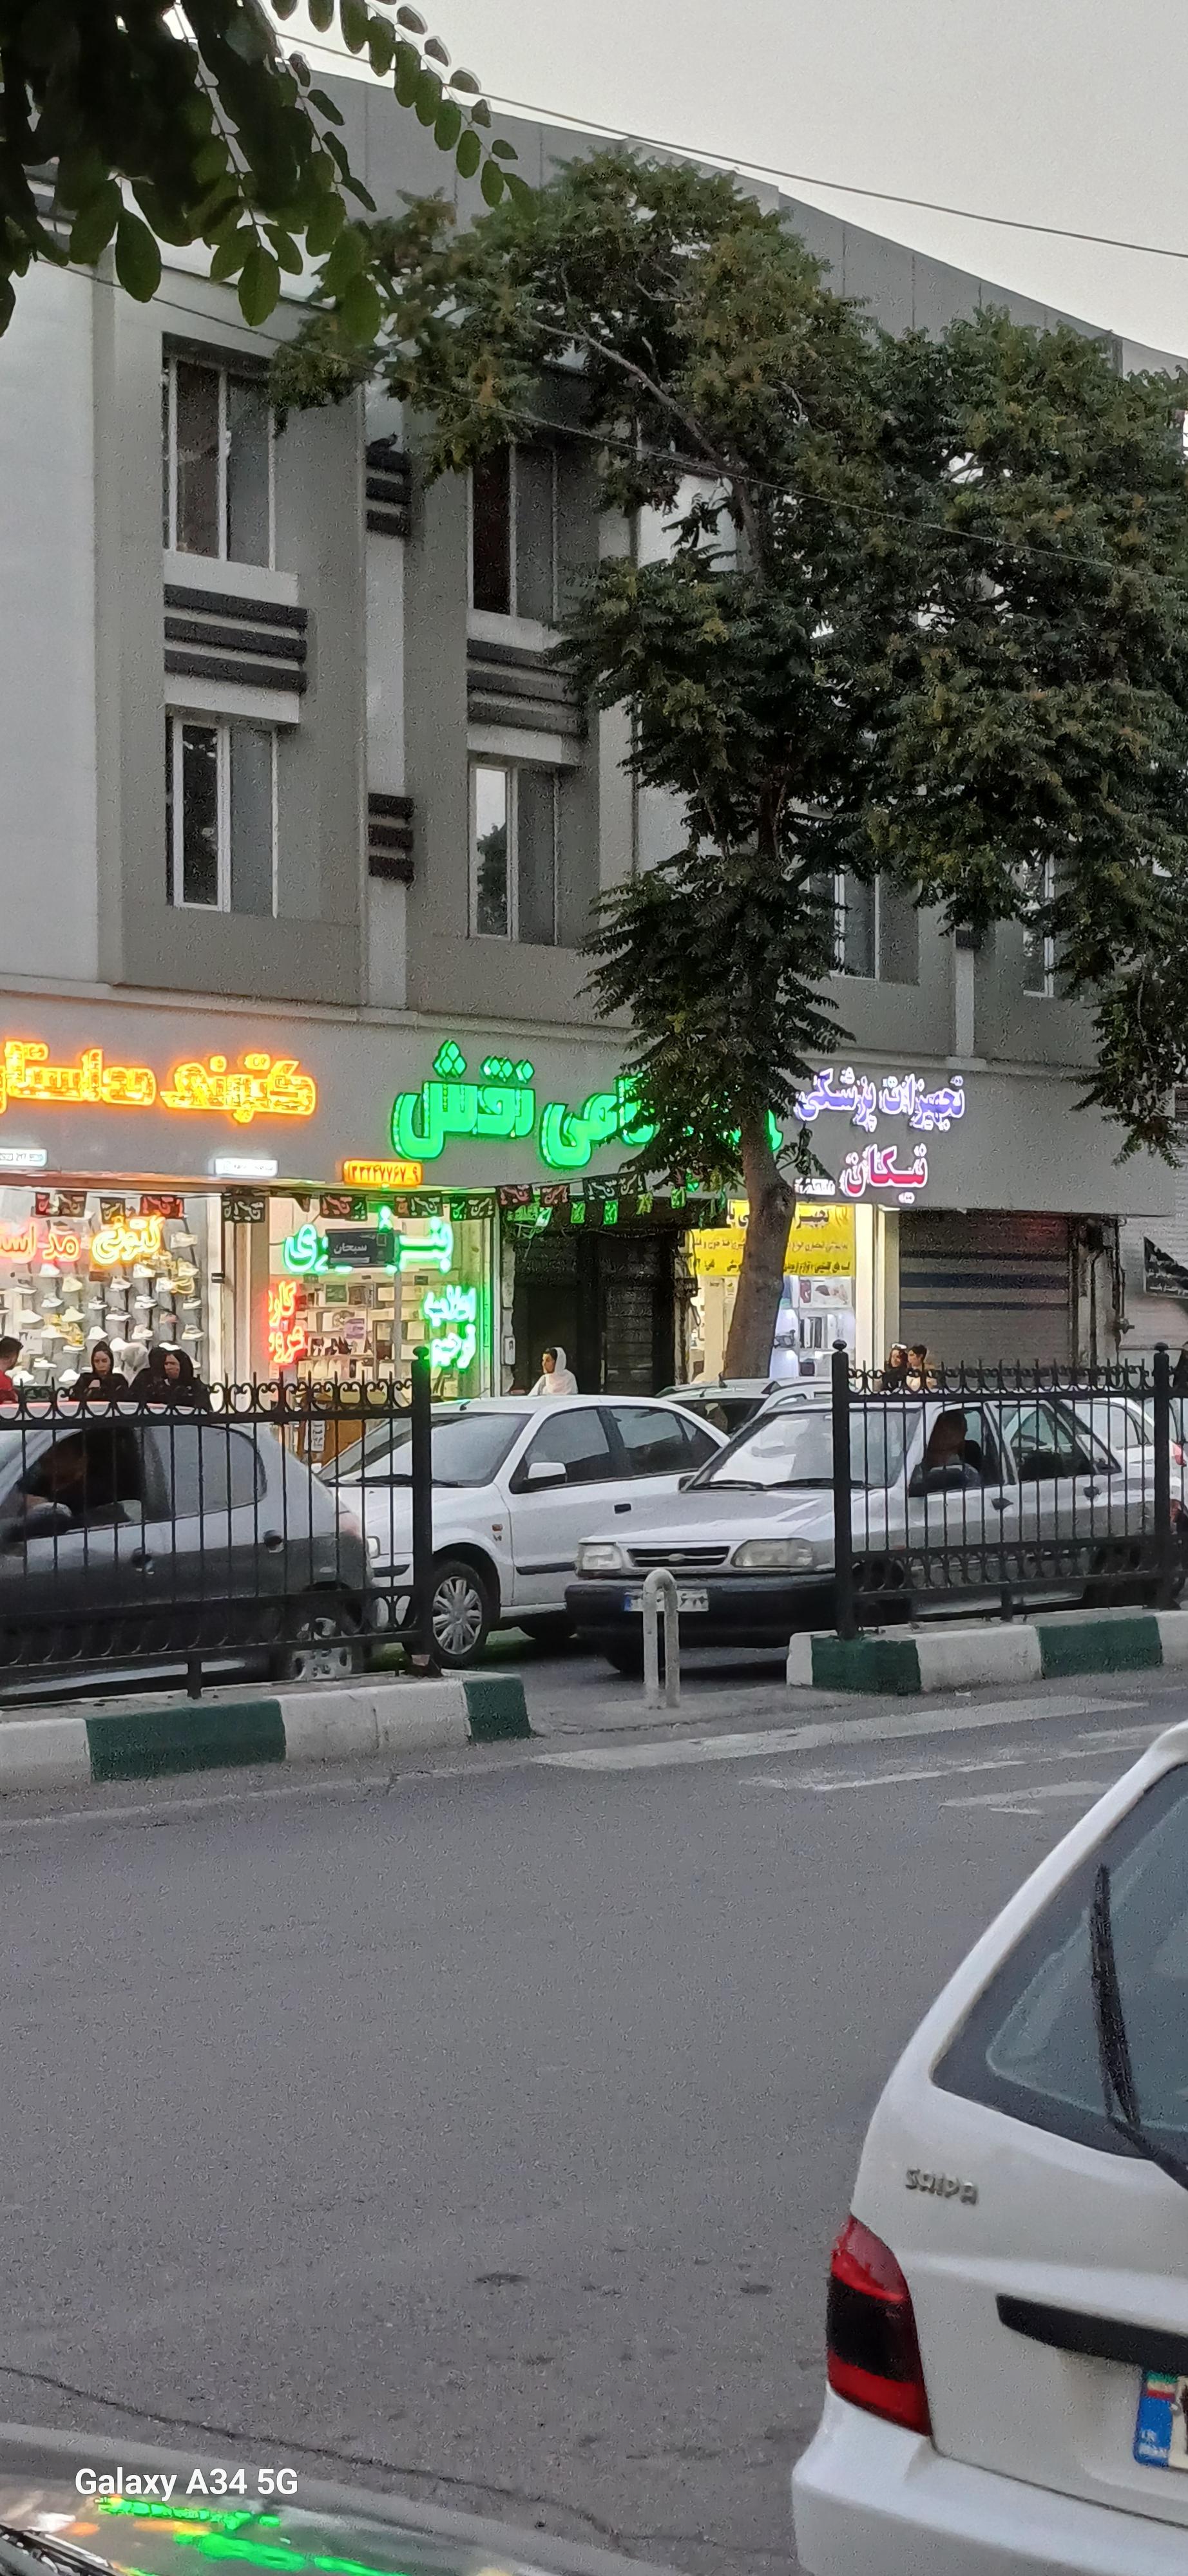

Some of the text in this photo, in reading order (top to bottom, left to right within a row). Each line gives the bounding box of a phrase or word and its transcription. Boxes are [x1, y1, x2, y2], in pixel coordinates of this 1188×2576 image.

[793, 1066, 965, 1132] تجهیزات پزشکی
[839, 1142, 928, 1205] نیکان
